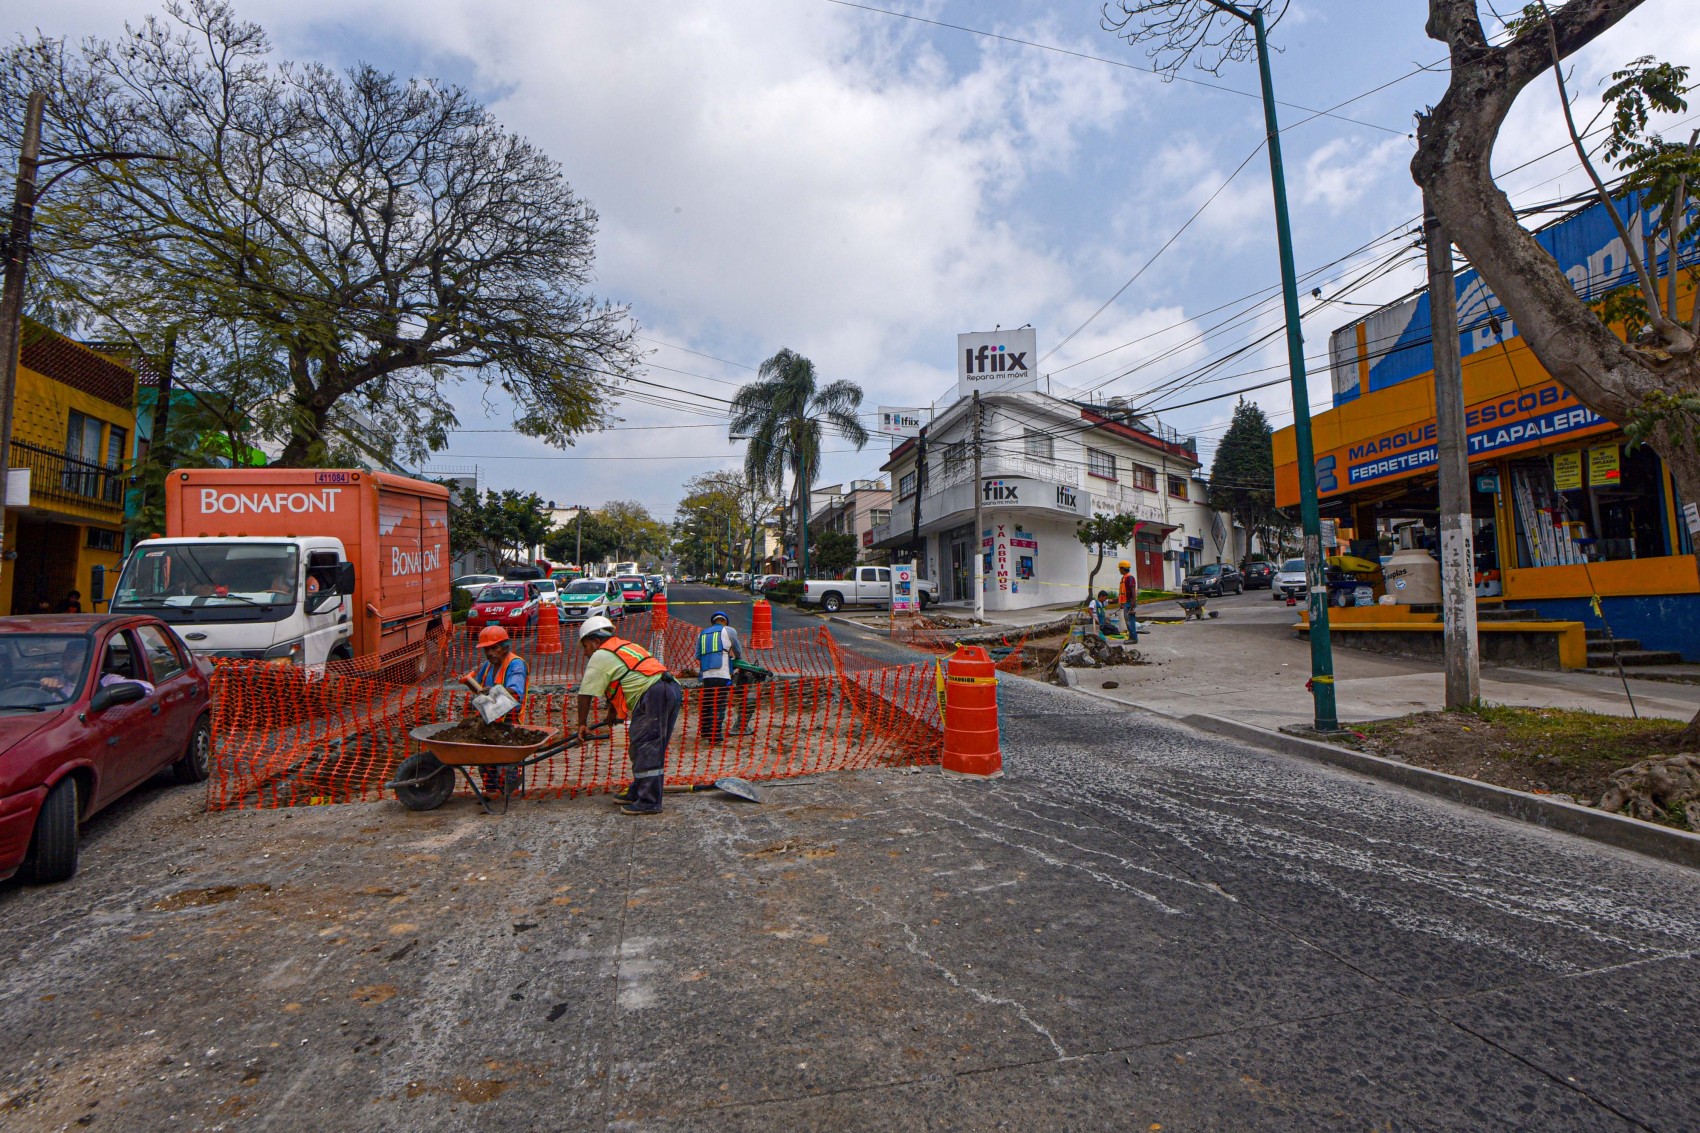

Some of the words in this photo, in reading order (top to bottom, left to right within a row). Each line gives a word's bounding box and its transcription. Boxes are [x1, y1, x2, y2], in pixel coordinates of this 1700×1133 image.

[967, 373, 995, 382] Repara
[1349, 424, 1437, 461] MARQUE
[319, 473, 345, 482] 411084
[980, 480, 1018, 500] fiix
[201, 489, 342, 514] BONAFONT
